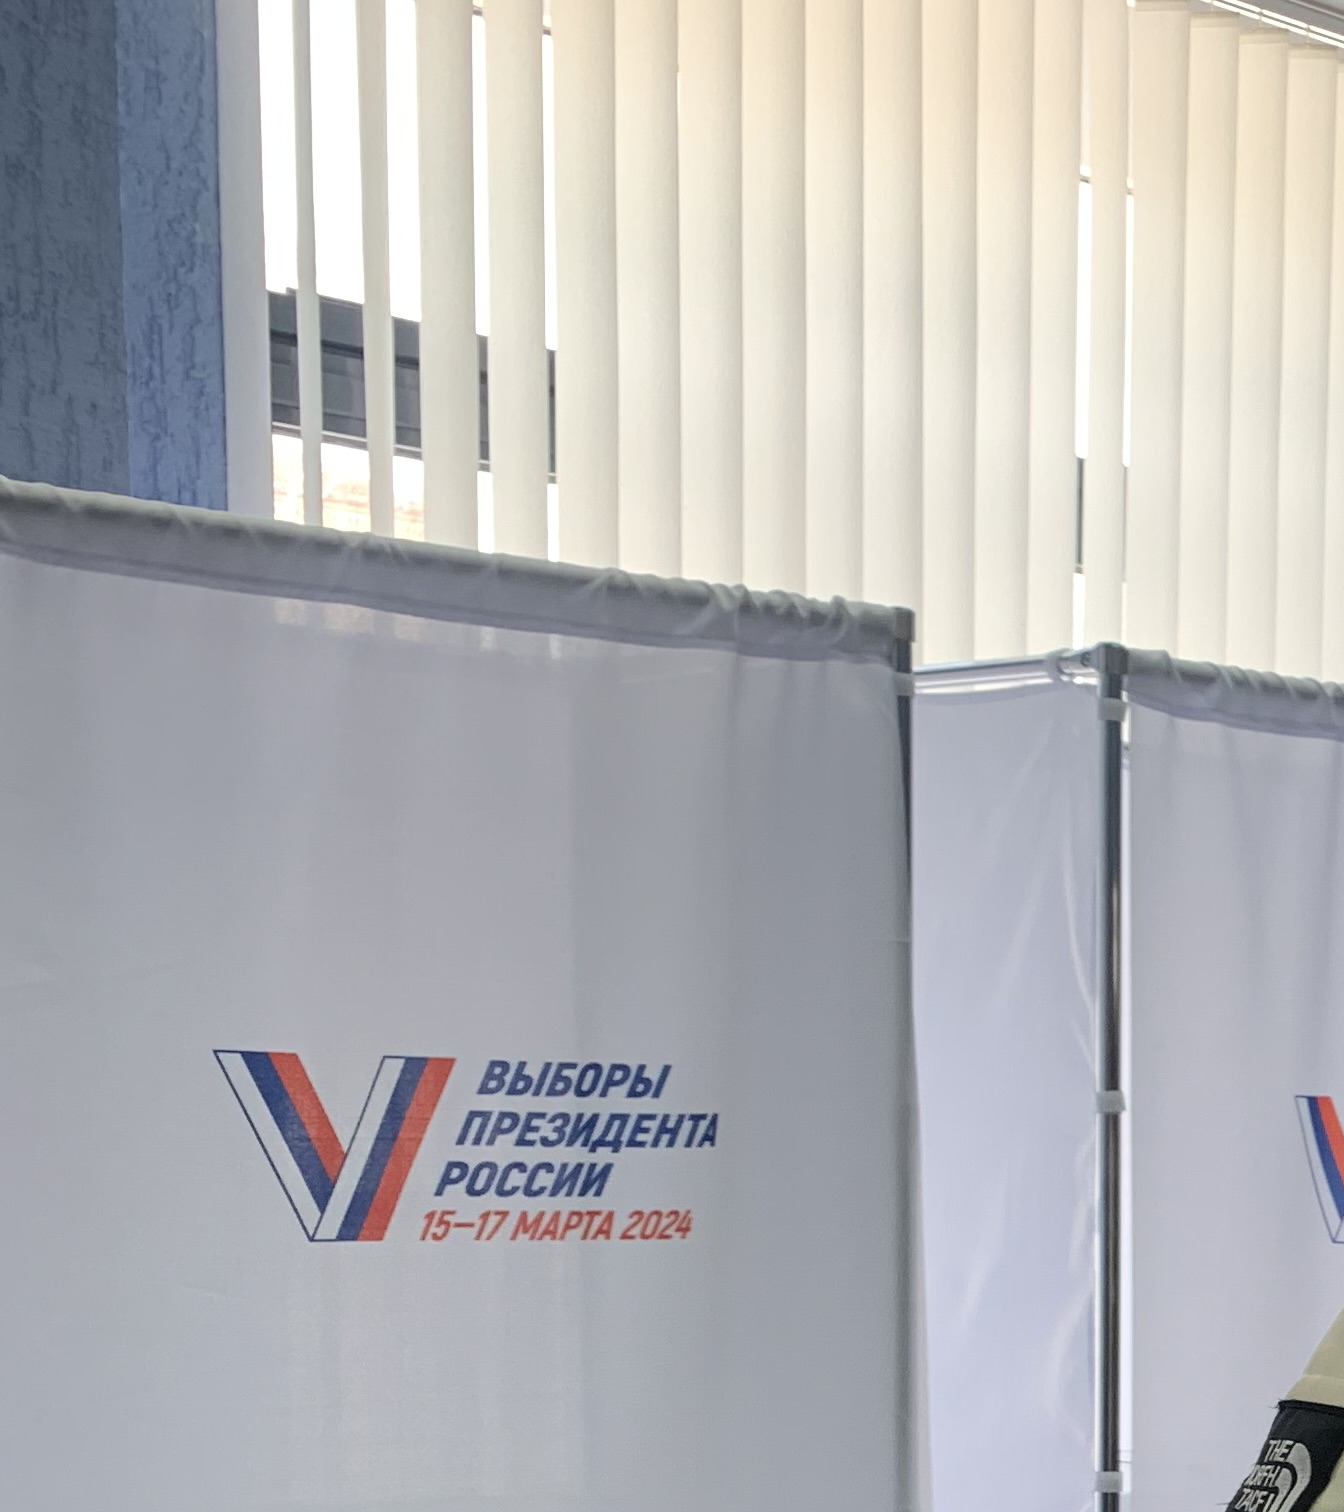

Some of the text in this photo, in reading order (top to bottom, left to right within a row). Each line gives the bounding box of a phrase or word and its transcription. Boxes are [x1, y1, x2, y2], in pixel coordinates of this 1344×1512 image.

[476, 1060, 672, 1098] ВЫБОРЫ
[455, 1110, 718, 1153] ПРЕЗИДЕНТА
[434, 1161, 614, 1197] РОССИИ
[510, 1210, 615, 1241] МАРТА
[619, 1209, 693, 1240] 2024
[1264, 1440, 1294, 1462] THE
